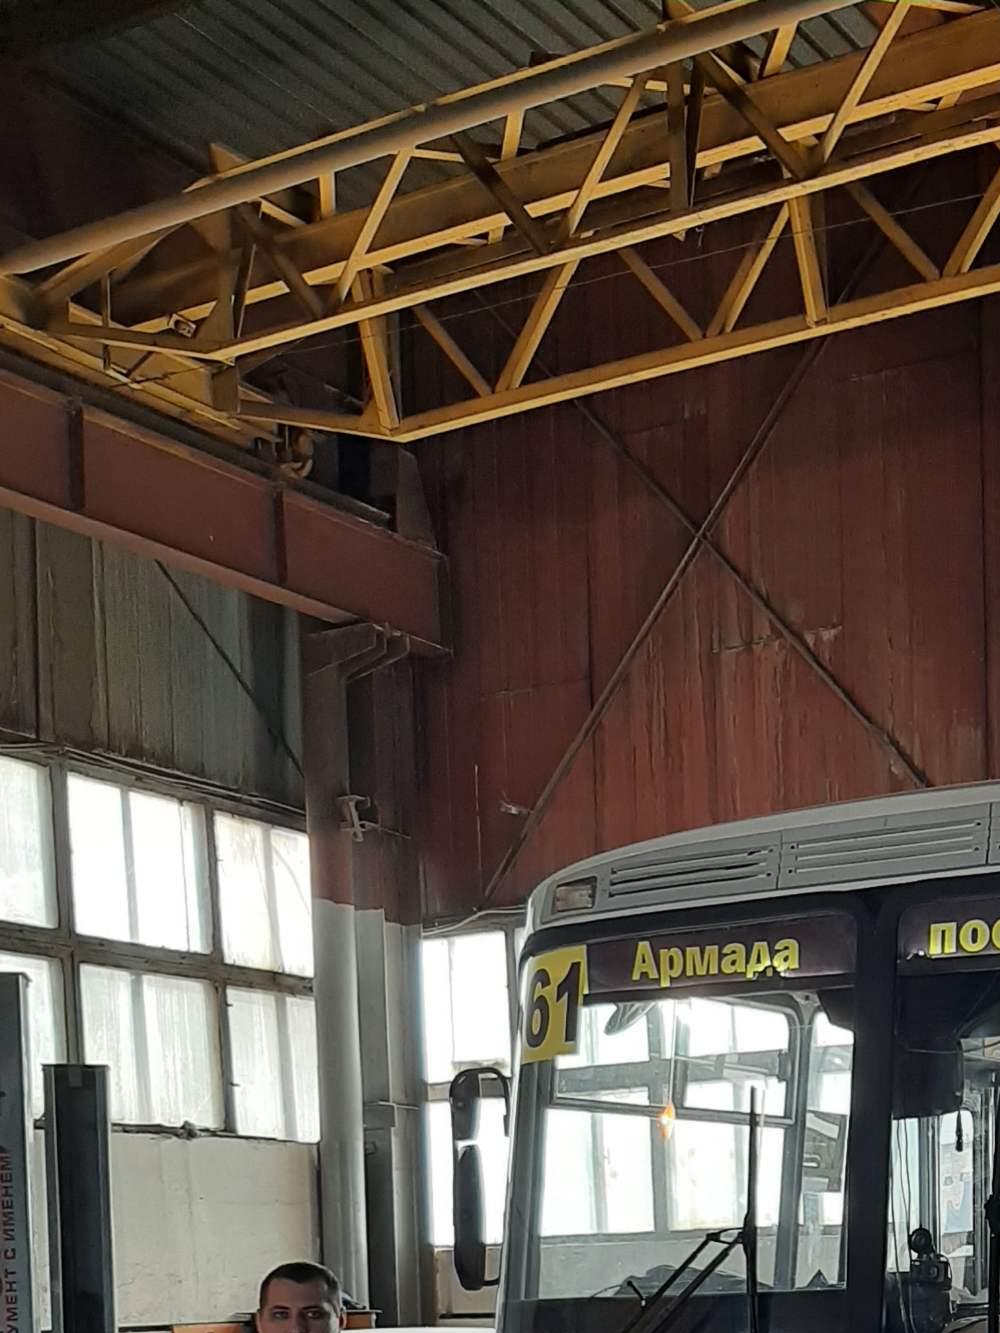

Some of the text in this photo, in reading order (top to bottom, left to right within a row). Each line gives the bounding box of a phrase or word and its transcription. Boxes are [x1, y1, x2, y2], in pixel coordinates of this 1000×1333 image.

[631, 938, 801, 988] Армада
[525, 961, 581, 1048] 61
[4, 1247, 16, 1260] С
